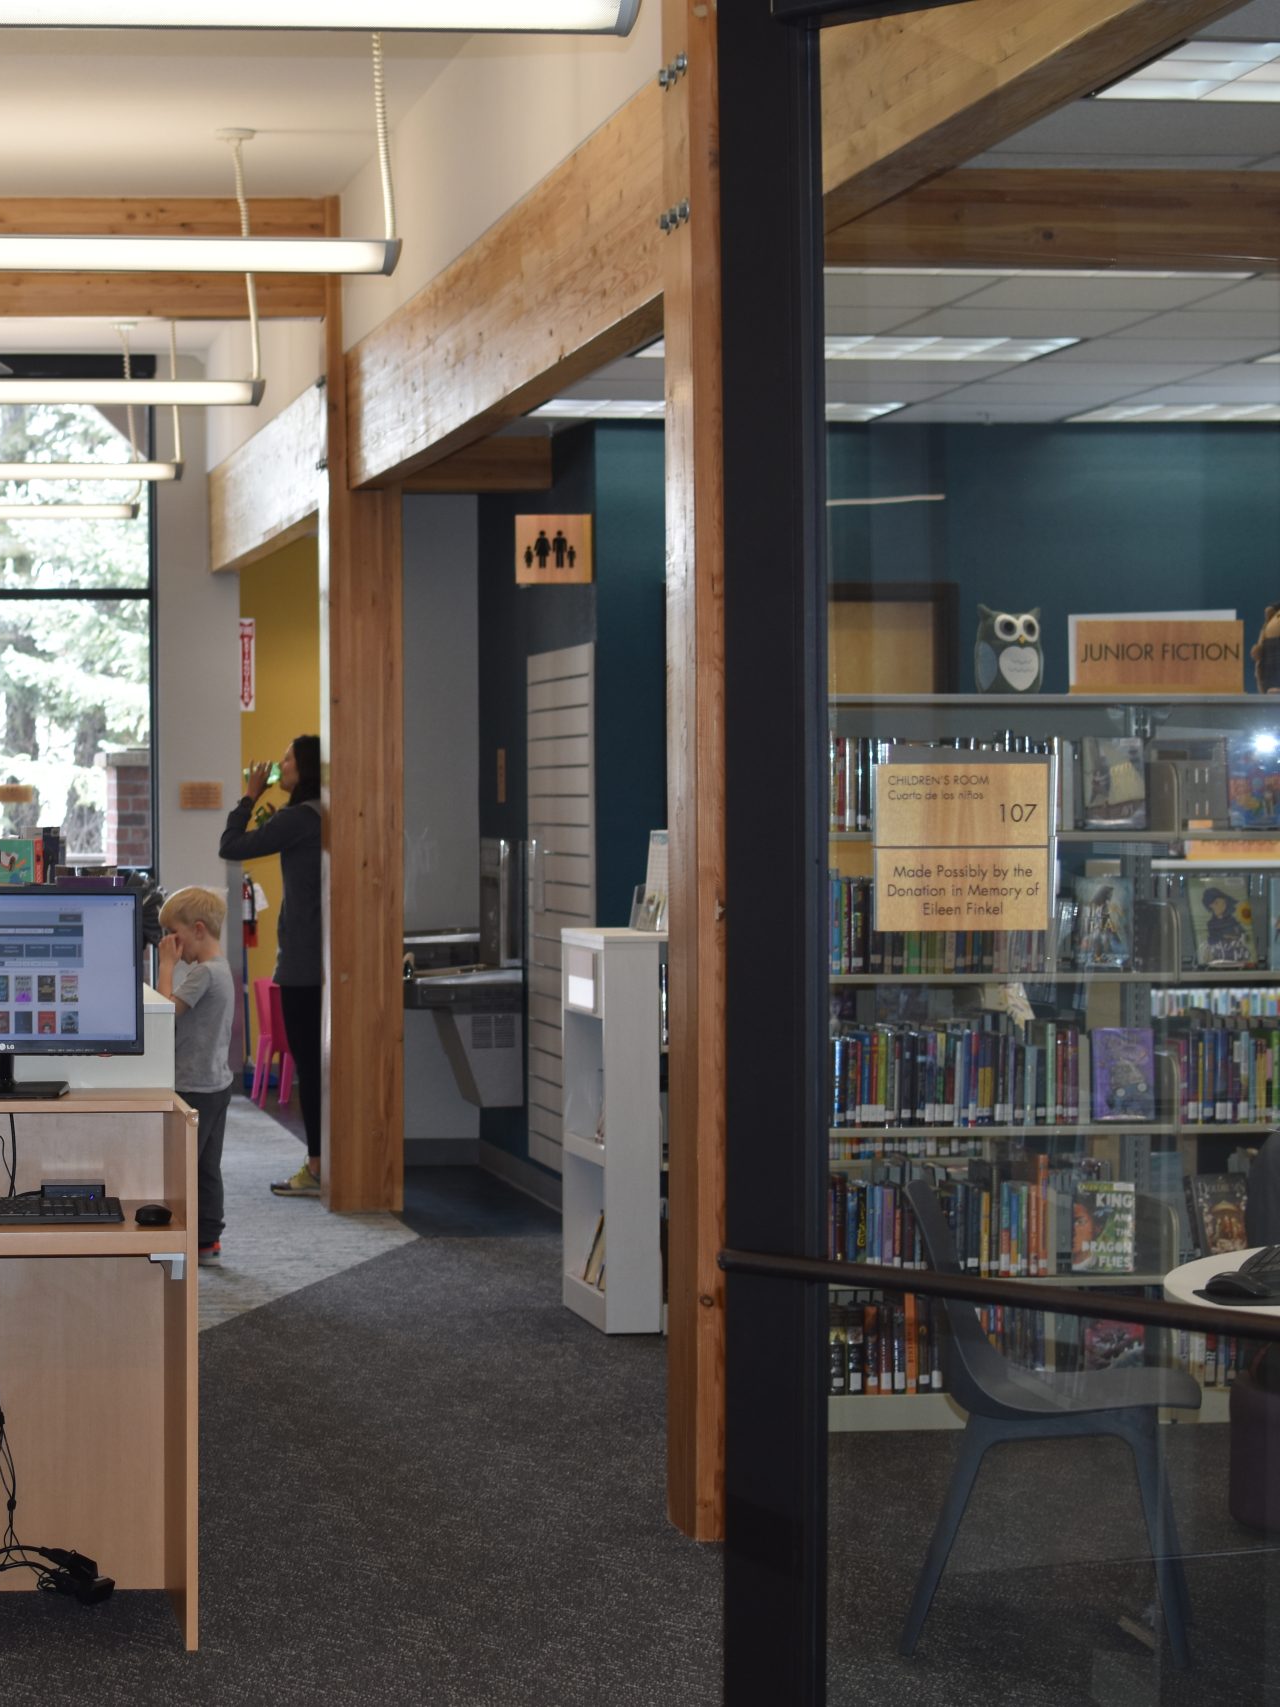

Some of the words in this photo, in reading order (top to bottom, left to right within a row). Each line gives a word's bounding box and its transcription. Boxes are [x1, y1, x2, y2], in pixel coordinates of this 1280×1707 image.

[1081, 643, 1154, 663] JUNIOR
[1161, 642, 1239, 662] FICTION
[887, 775, 950, 786] CHILDREN'S
[953, 775, 990, 786] ROOM
[888, 790, 922, 801] Cuarto
[925, 790, 938, 801] de
[941, 790, 955, 801] los
[958, 790, 984, 801] niños
[999, 803, 1038, 823] 107
[893, 864, 932, 878] Made
[936, 864, 989, 882] Possibly
[992, 864, 1009, 882] by
[1012, 864, 1033, 878] the
[887, 884, 946, 897] Donation
[951, 884, 963, 897] in
[967, 884, 1022, 900] Memory
[1026, 882, 1040, 896] of
[922, 902, 961, 916] Eileen
[966, 902, 1003, 916] Finkel
[1095, 1193, 1134, 1208] KING
[1081, 1241, 1133, 1253] DRAGON
[1098, 1255, 1133, 1269] FLIES
